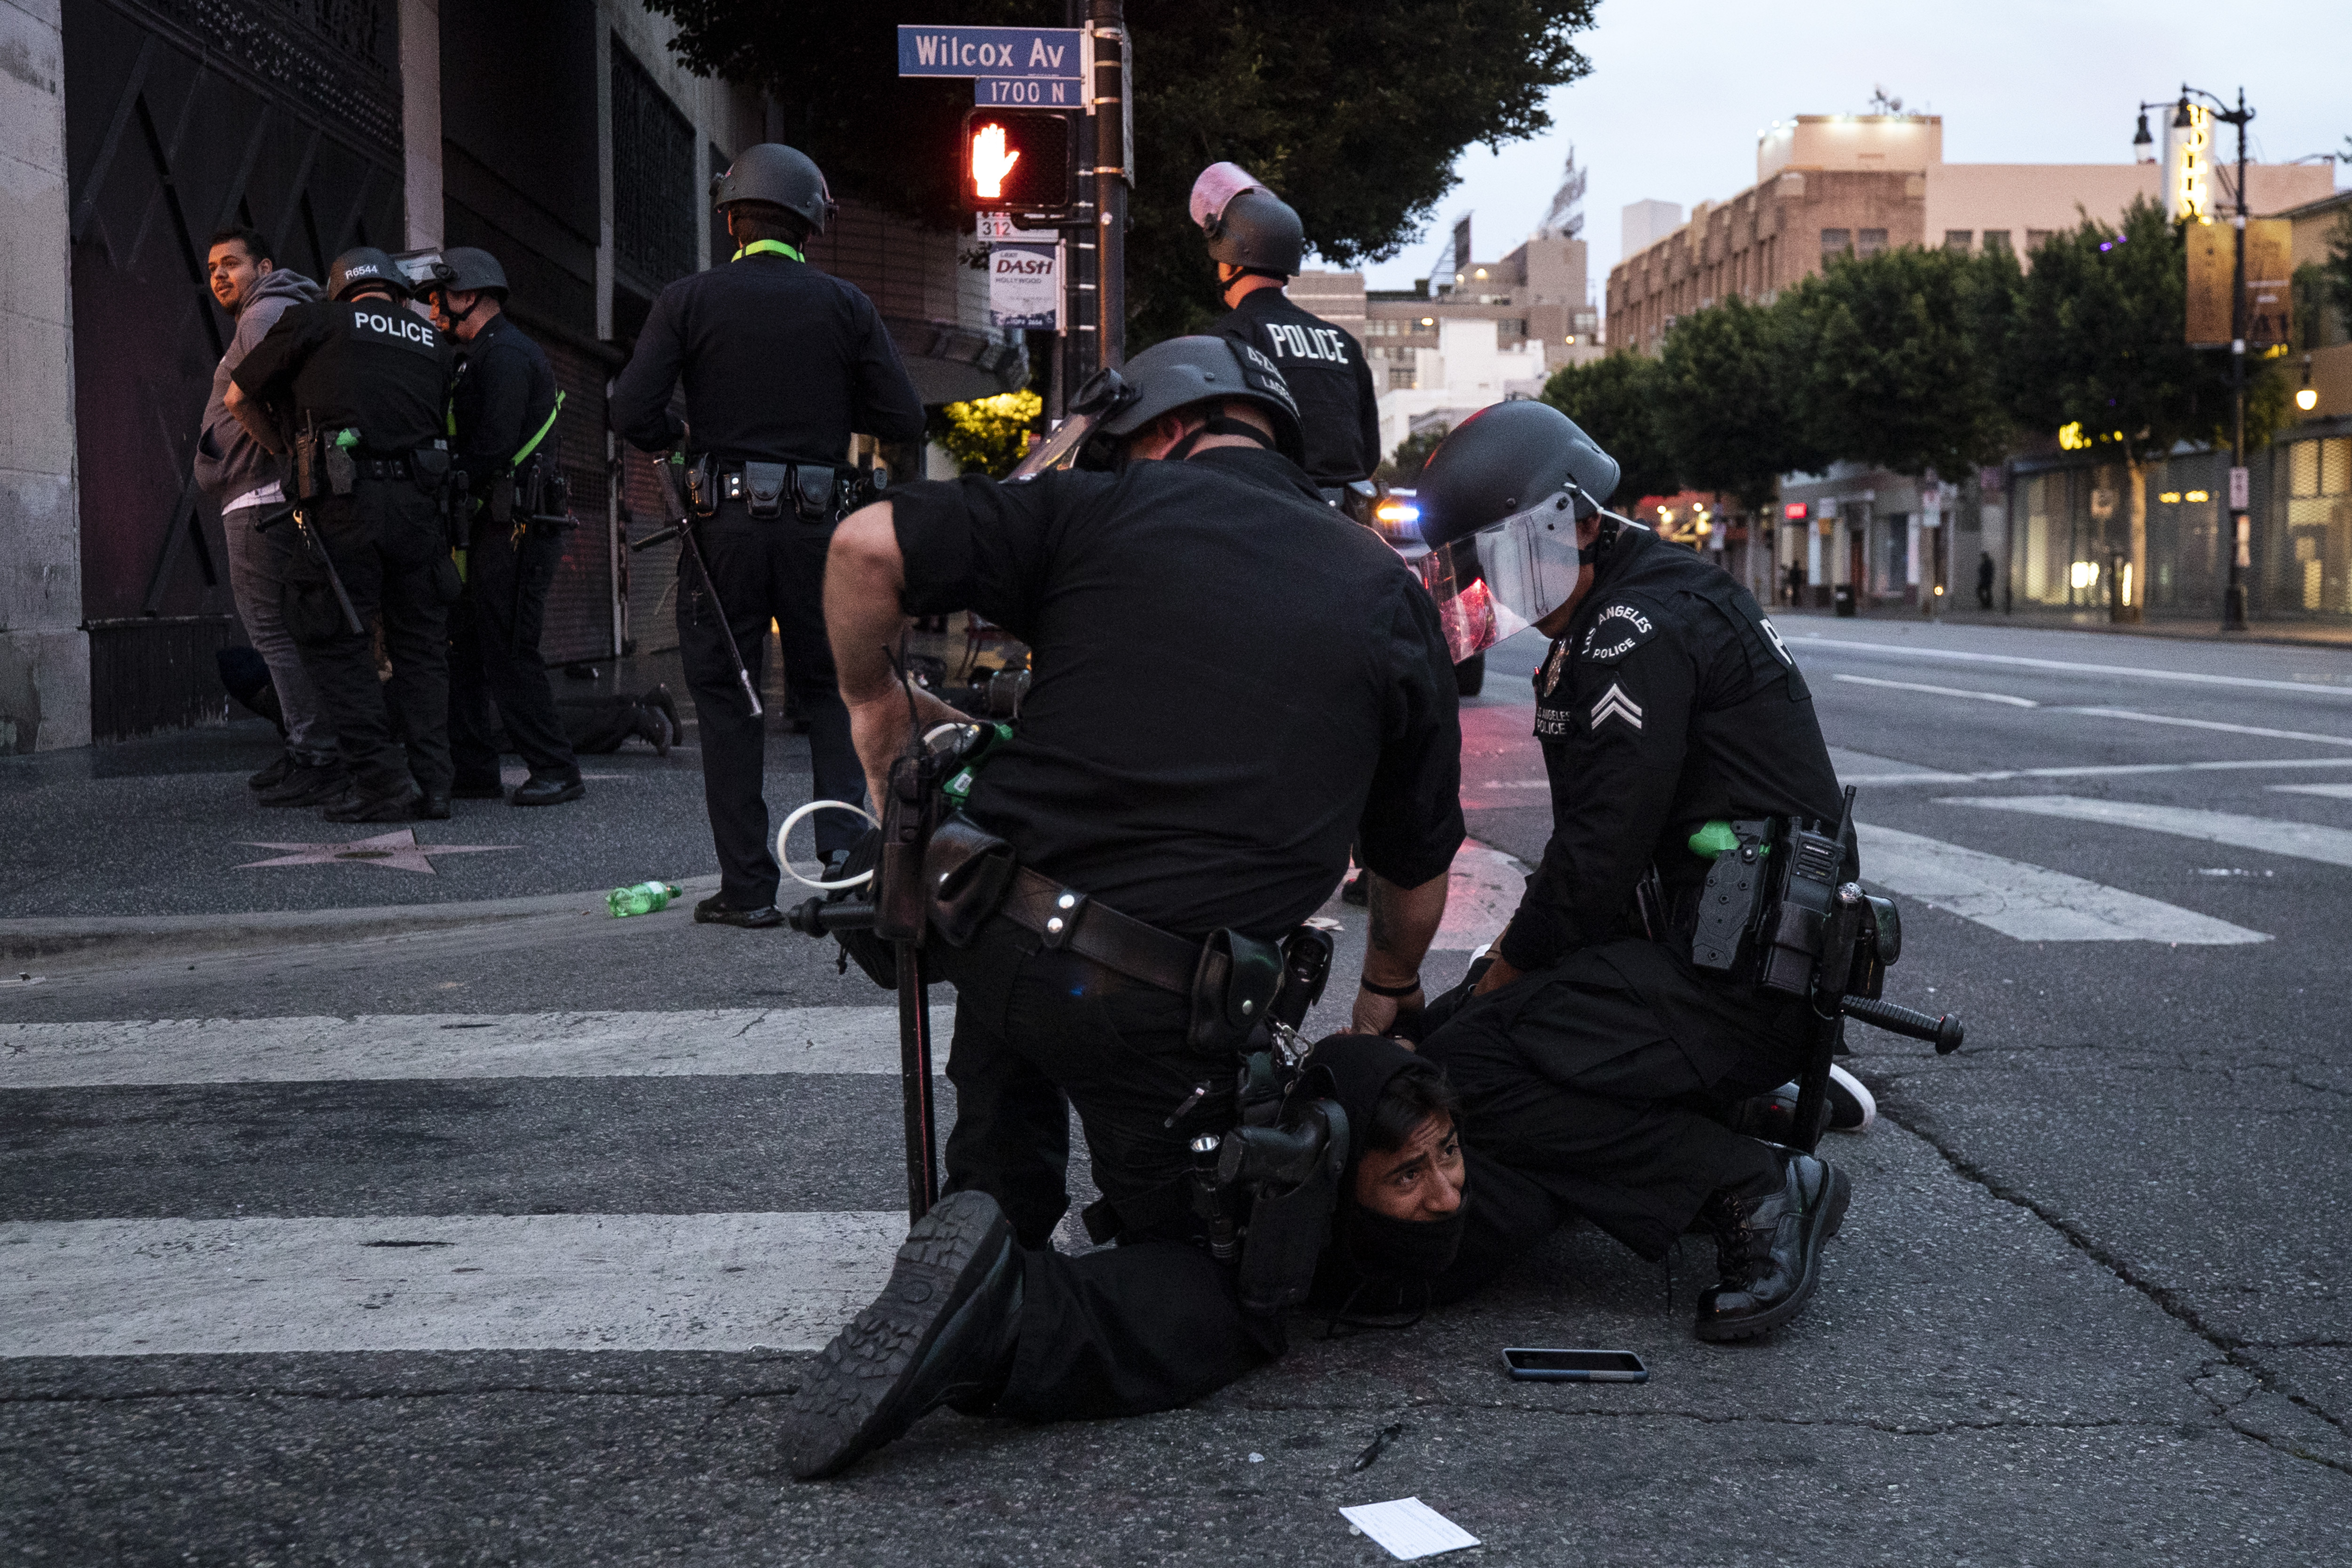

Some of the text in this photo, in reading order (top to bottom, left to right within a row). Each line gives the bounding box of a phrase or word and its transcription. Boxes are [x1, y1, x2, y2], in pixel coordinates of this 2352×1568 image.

[915, 35, 1065, 68] Wilcox Av
[992, 82, 1065, 103] 1700 N
[982, 222, 1011, 235] 312
[345, 265, 378, 280] R6544
[996, 259, 1053, 274] DASH
[355, 311, 434, 347] POLICE
[1265, 323, 1349, 364] POLICE
[1598, 605, 1653, 634] ANGELES
[1592, 637, 1636, 659] POLICE
[1537, 718, 1567, 734] POLICE
